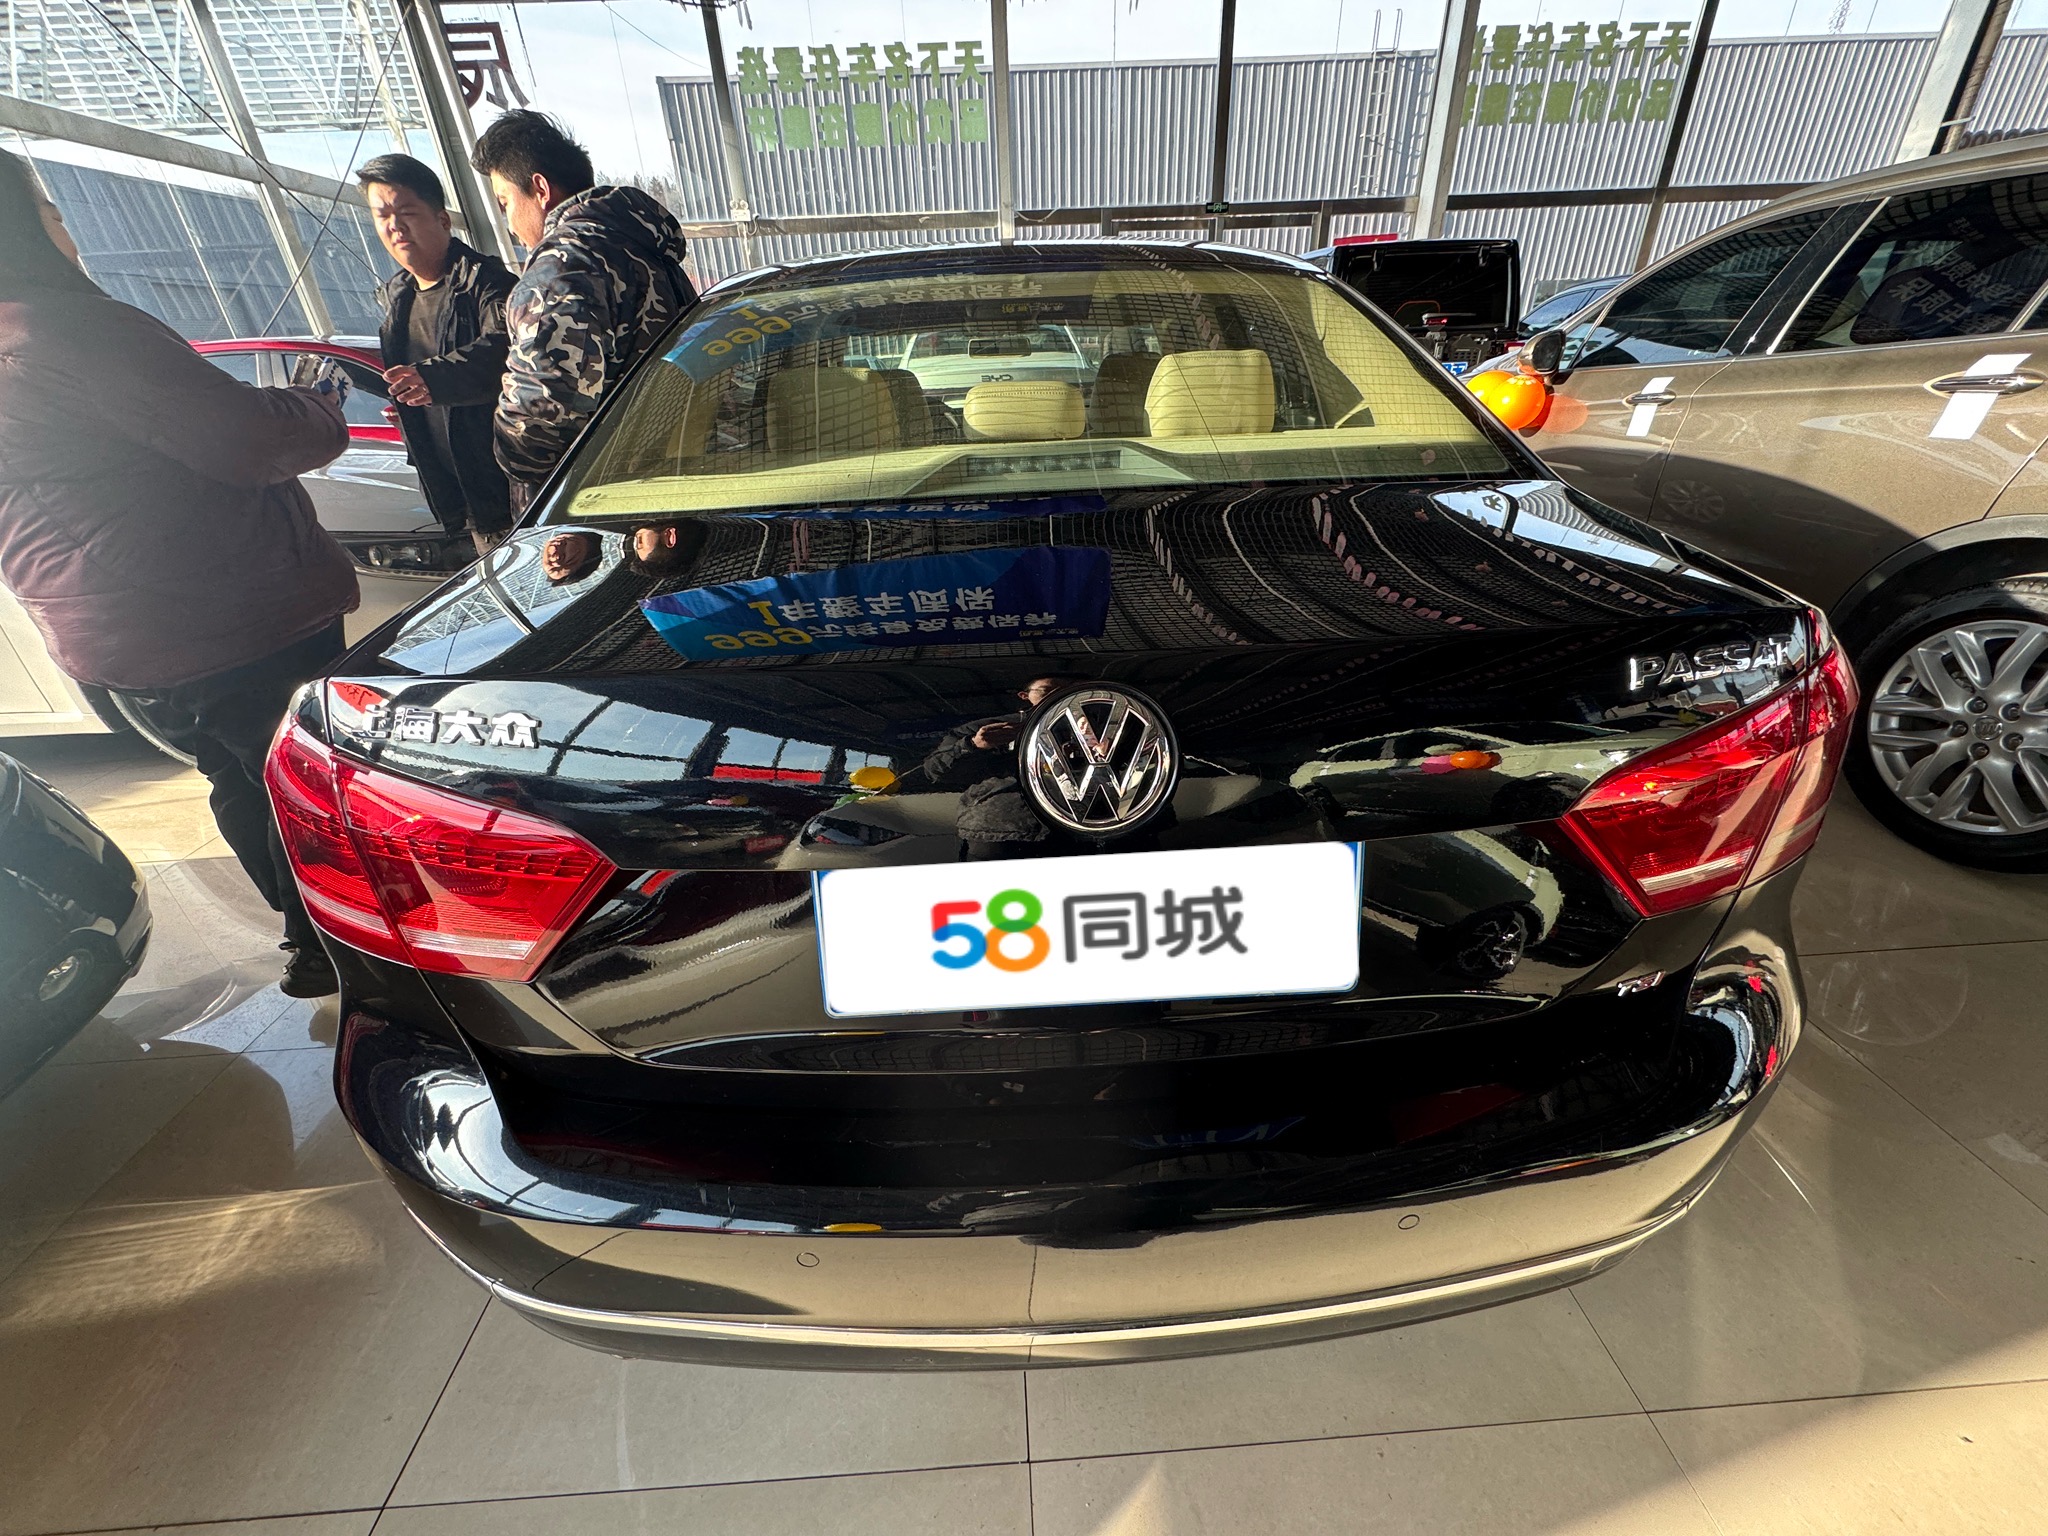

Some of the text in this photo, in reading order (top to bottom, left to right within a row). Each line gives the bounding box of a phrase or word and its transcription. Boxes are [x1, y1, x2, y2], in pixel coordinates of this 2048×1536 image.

[1630, 633, 1793, 691] PASSAT
[352, 703, 542, 749] 上海大众
